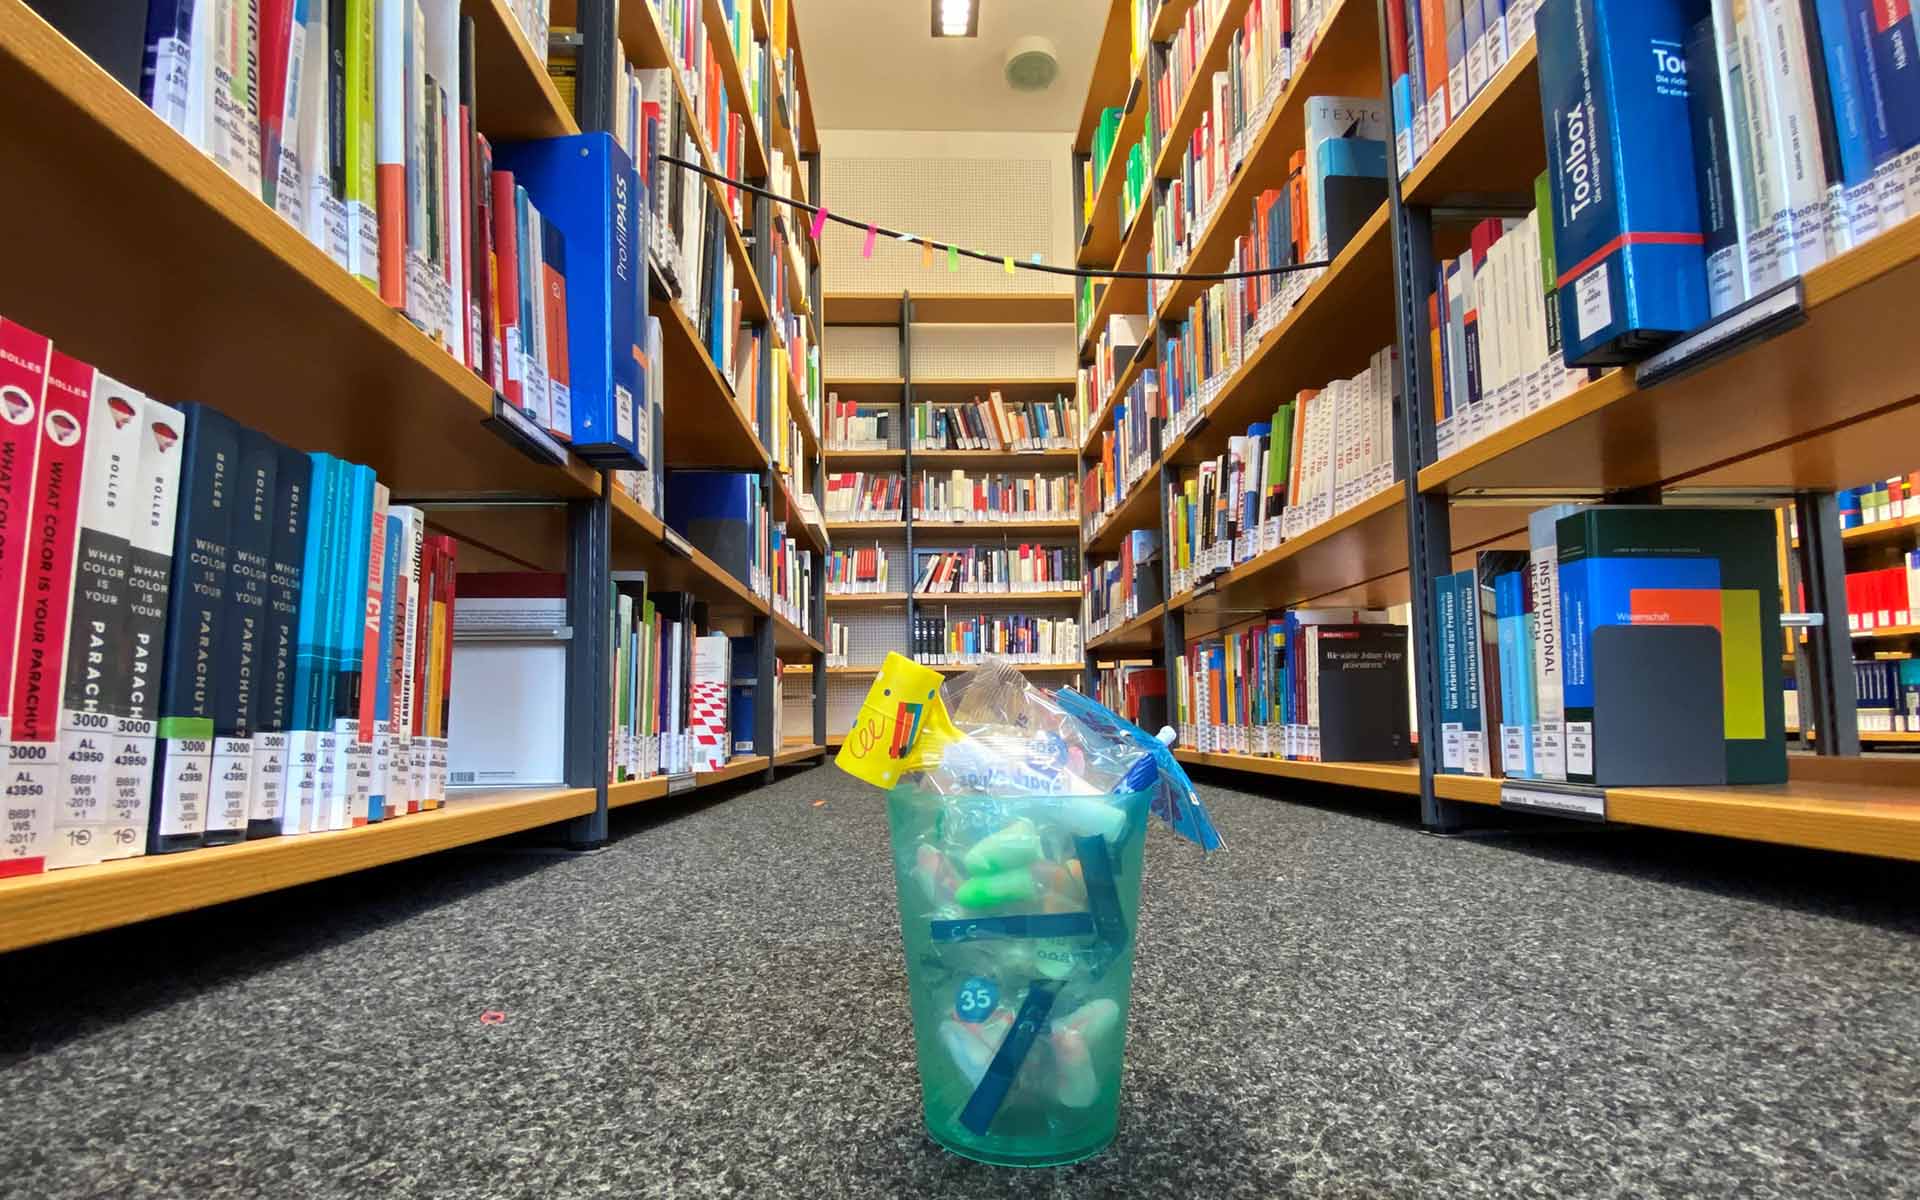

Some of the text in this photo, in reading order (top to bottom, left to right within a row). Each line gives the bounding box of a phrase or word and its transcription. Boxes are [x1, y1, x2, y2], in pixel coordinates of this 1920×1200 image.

[1566, 102, 1591, 221] Toolbox
[616, 173, 628, 281] ProfilPASS
[0, 349, 42, 374] BOLLES
[47, 375, 88, 398] BOLLES
[49, 461, 64, 509] WHAT
[107, 454, 121, 508] BOLLES
[212, 452, 225, 508] BOLLES
[152, 477, 164, 527] BOLLES
[254, 469, 265, 521] BOLLES
[289, 485, 300, 534] BOLLES
[41, 514, 58, 571] COLOR
[195, 538, 226, 556] WHAT
[88, 547, 124, 565] WHAT
[190, 553, 226, 571] COLOR
[238, 550, 267, 567] WHAT
[413, 530, 423, 584] campus
[83, 561, 125, 579] COLOR
[133, 565, 167, 580] WHAT
[205, 571, 215, 582] IS
[232, 564, 267, 581] COLOR
[365, 511, 386, 633] brilliant CV
[37, 576, 51, 592] IS
[97, 579, 109, 590] IS
[129, 578, 168, 593] COLOR
[193, 583, 222, 598] YOUR
[247, 581, 257, 592] IS
[85, 590, 118, 606] YOUR
[142, 594, 153, 604] IS
[235, 592, 263, 607] YOUR
[131, 604, 162, 618] YOUR
[272, 600, 297, 615] YOUR
[1465, 587, 1473, 626] Professur
[33, 598, 50, 644] YOUR
[1540, 560, 1555, 677] INSTITUTIONAL
[1446, 591, 1459, 709] Vom Arbeiterkind zur Professur
[193, 610, 213, 715] PARACHUT
[1467, 641, 1477, 691] Arbeiterkind
[73, 713, 108, 728] 3000
[118, 719, 150, 734] 3000
[80, 739, 96, 749] AL
[125, 744, 139, 754] AL
[181, 741, 206, 753] 3000
[226, 742, 250, 753] 3000
[264, 737, 285, 747] 3000
[9, 746, 46, 759] 3000
[68, 752, 104, 763] 43950
[269, 755, 278, 764] AL
[115, 756, 147, 766] 43950
[185, 762, 198, 771] AL
[232, 763, 244, 771] AL
[16, 772, 34, 782] AL
[6, 784, 43, 796] 43950
[75, 787, 91, 796] W5
[120, 788, 136, 797] W5
[12, 821, 31, 831] W5
[960, 989, 991, 1011] 35
